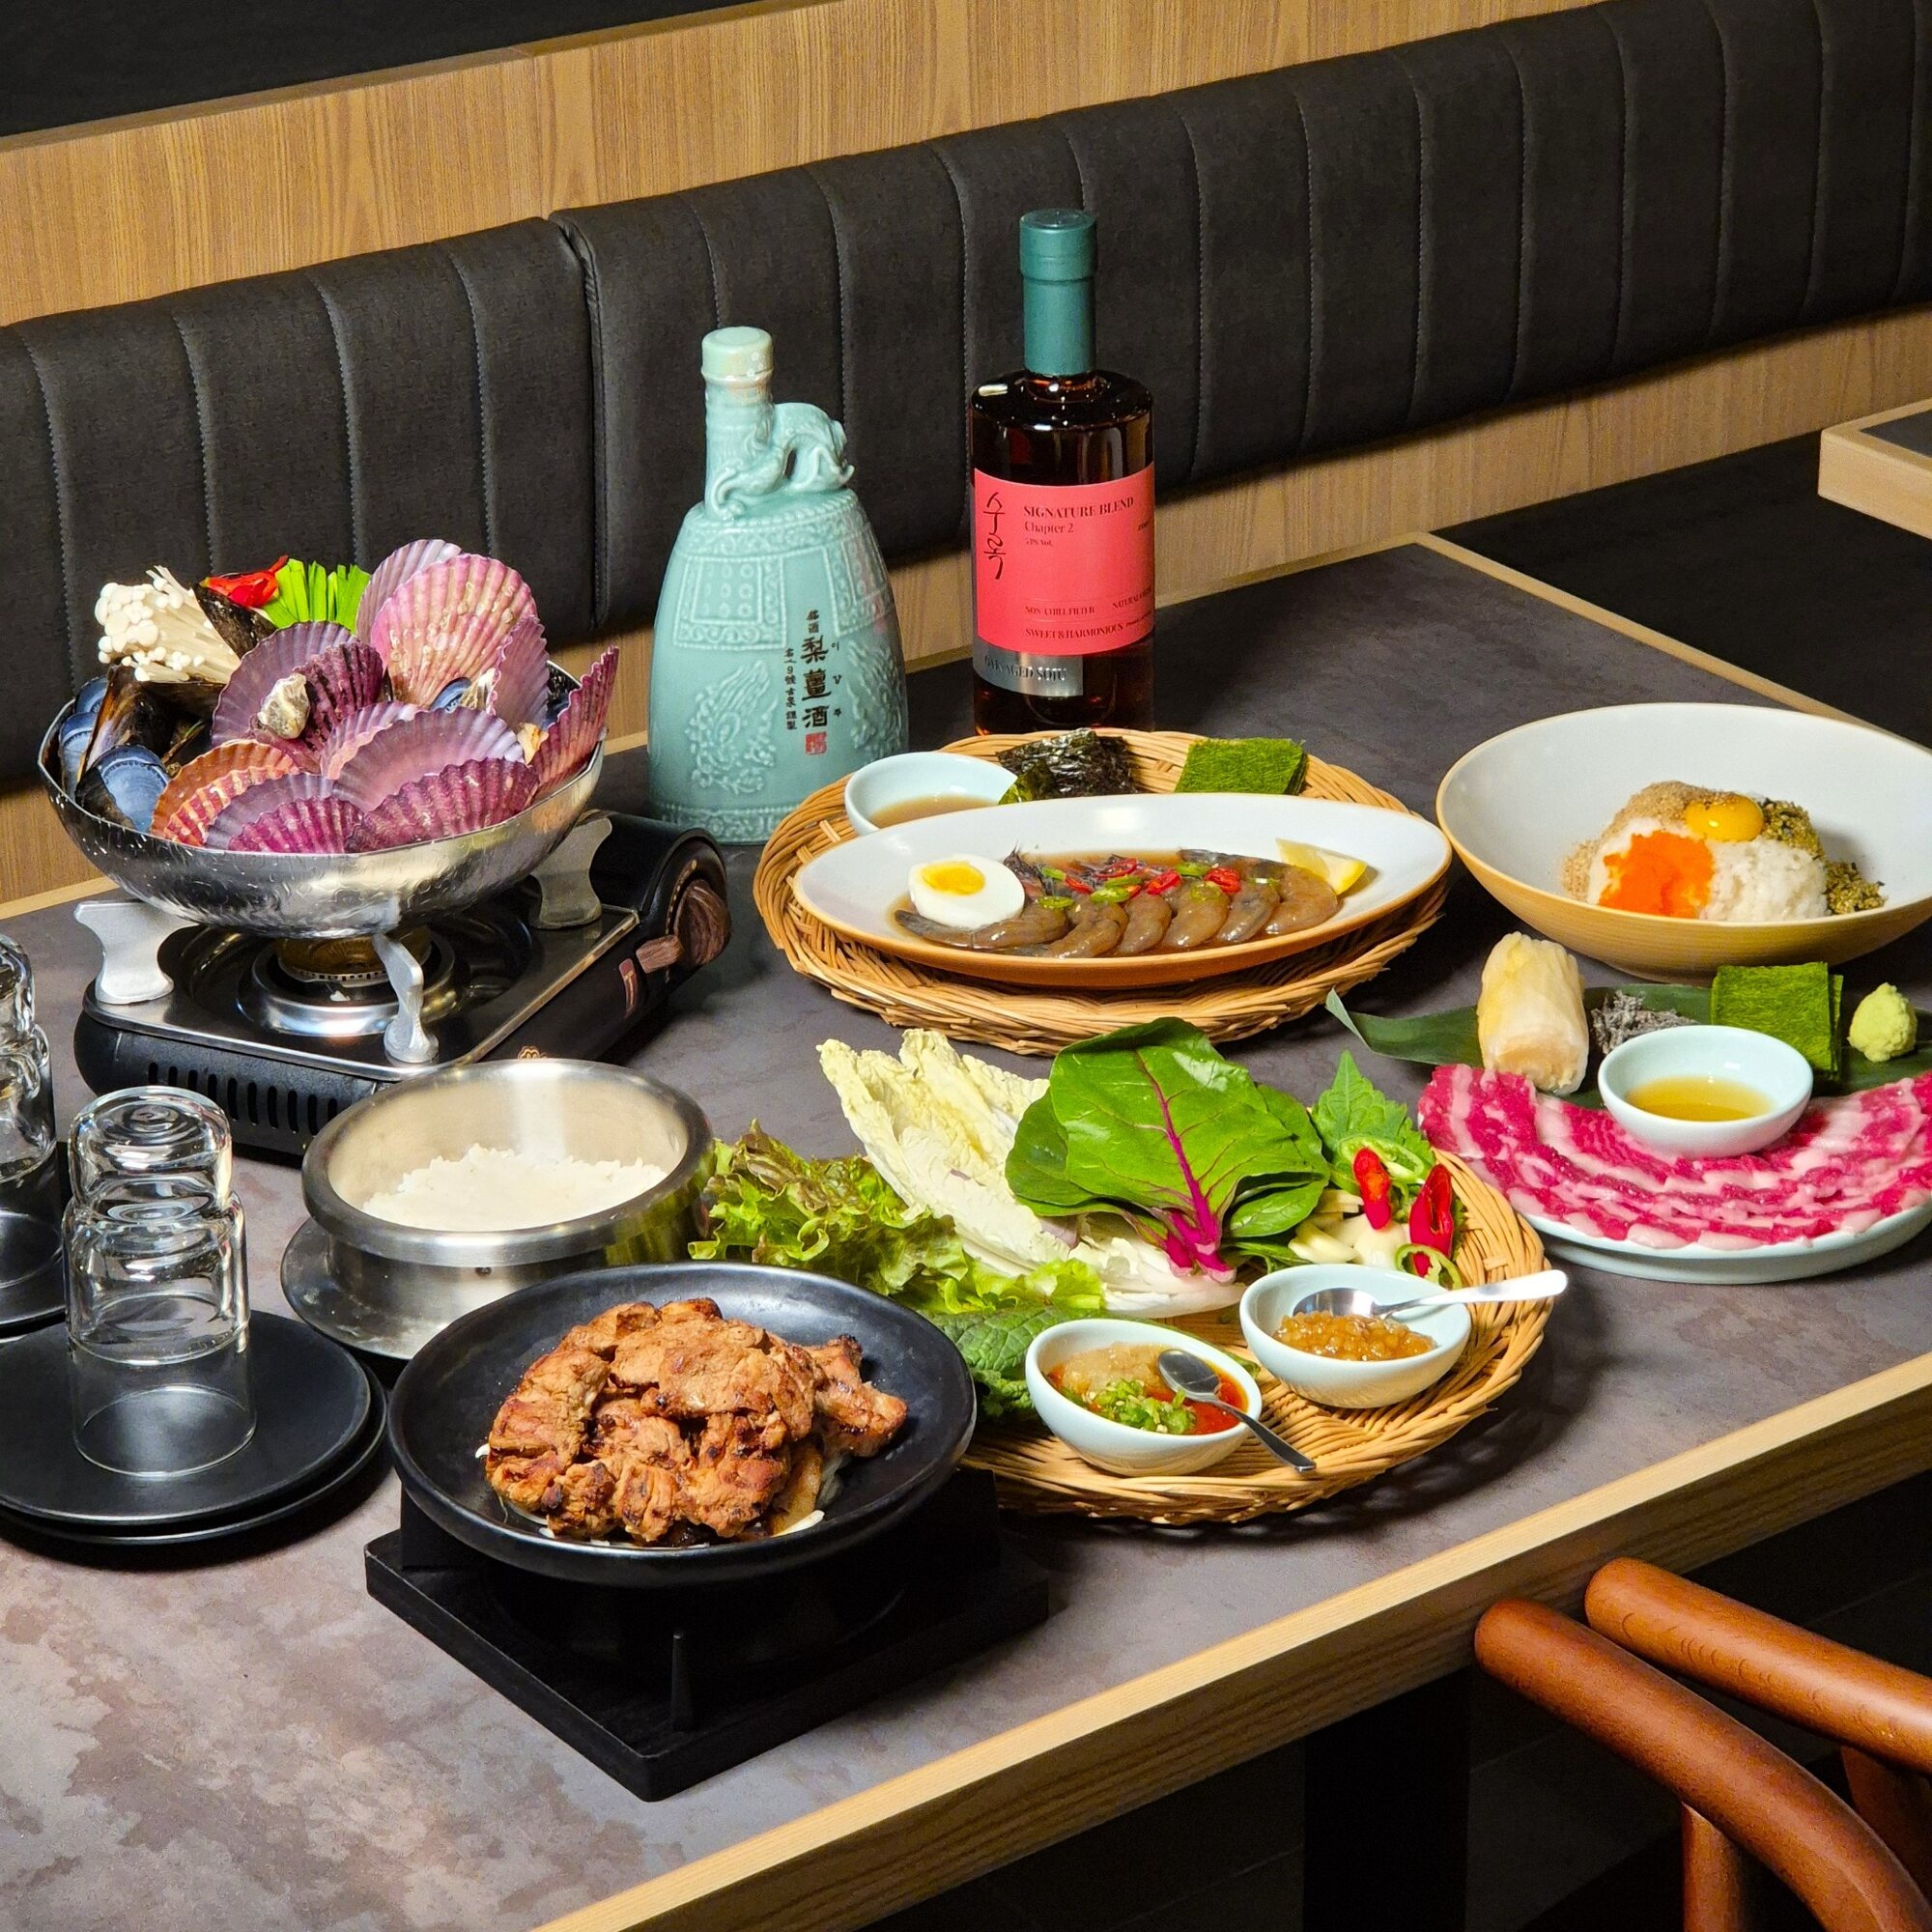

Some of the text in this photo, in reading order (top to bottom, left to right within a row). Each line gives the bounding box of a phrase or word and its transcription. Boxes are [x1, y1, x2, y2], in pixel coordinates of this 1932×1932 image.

[1024, 497, 1134, 519] SIGNATURE BLEND
[1024, 521, 1074, 535] Chapter 2
